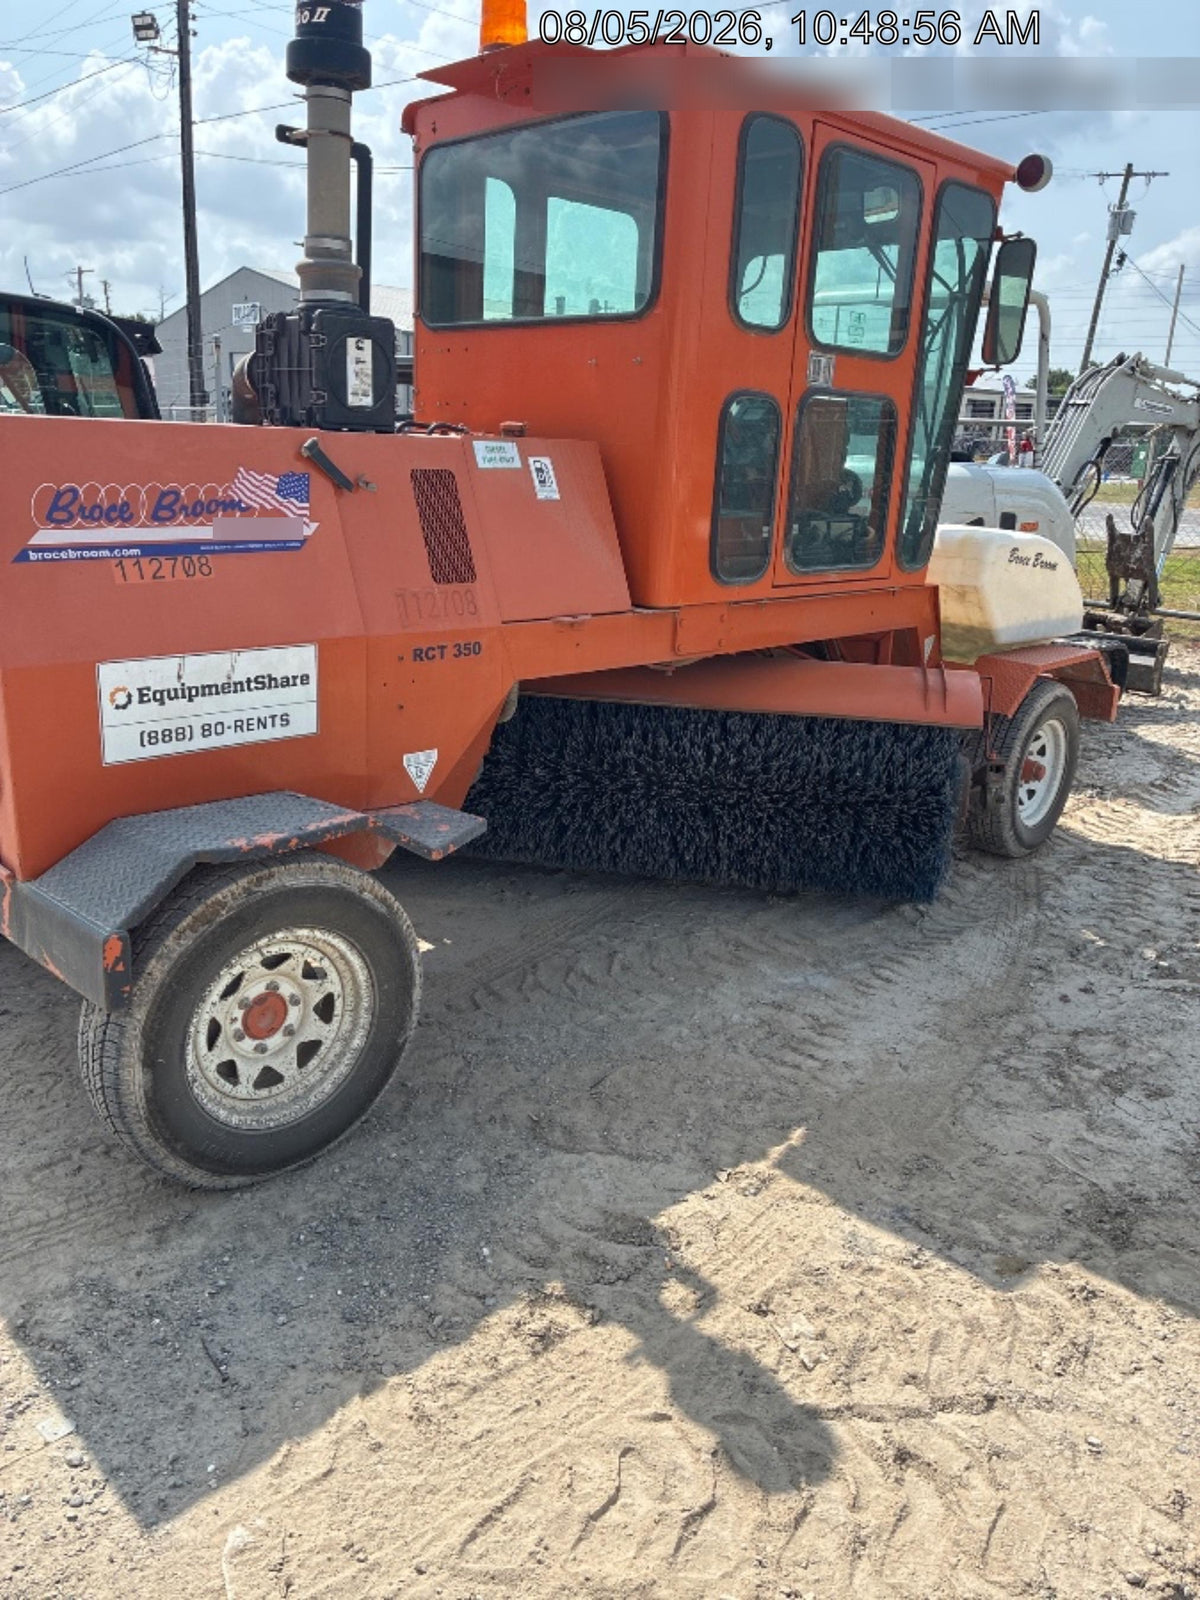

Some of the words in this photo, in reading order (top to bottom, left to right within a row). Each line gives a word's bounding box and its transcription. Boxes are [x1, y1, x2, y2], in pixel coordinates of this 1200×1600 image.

[45, 486, 135, 525] Broce
[151, 489, 250, 523] Broom
[28, 547, 142, 562] brocebroom.com
[114, 555, 214, 583] 112708
[412, 644, 448, 662] RCT
[453, 641, 482, 658] 350
[136, 672, 311, 706] EquipmentShare
[138, 724, 194, 748] (888)
[201, 712, 291, 738] 80-RENTS
